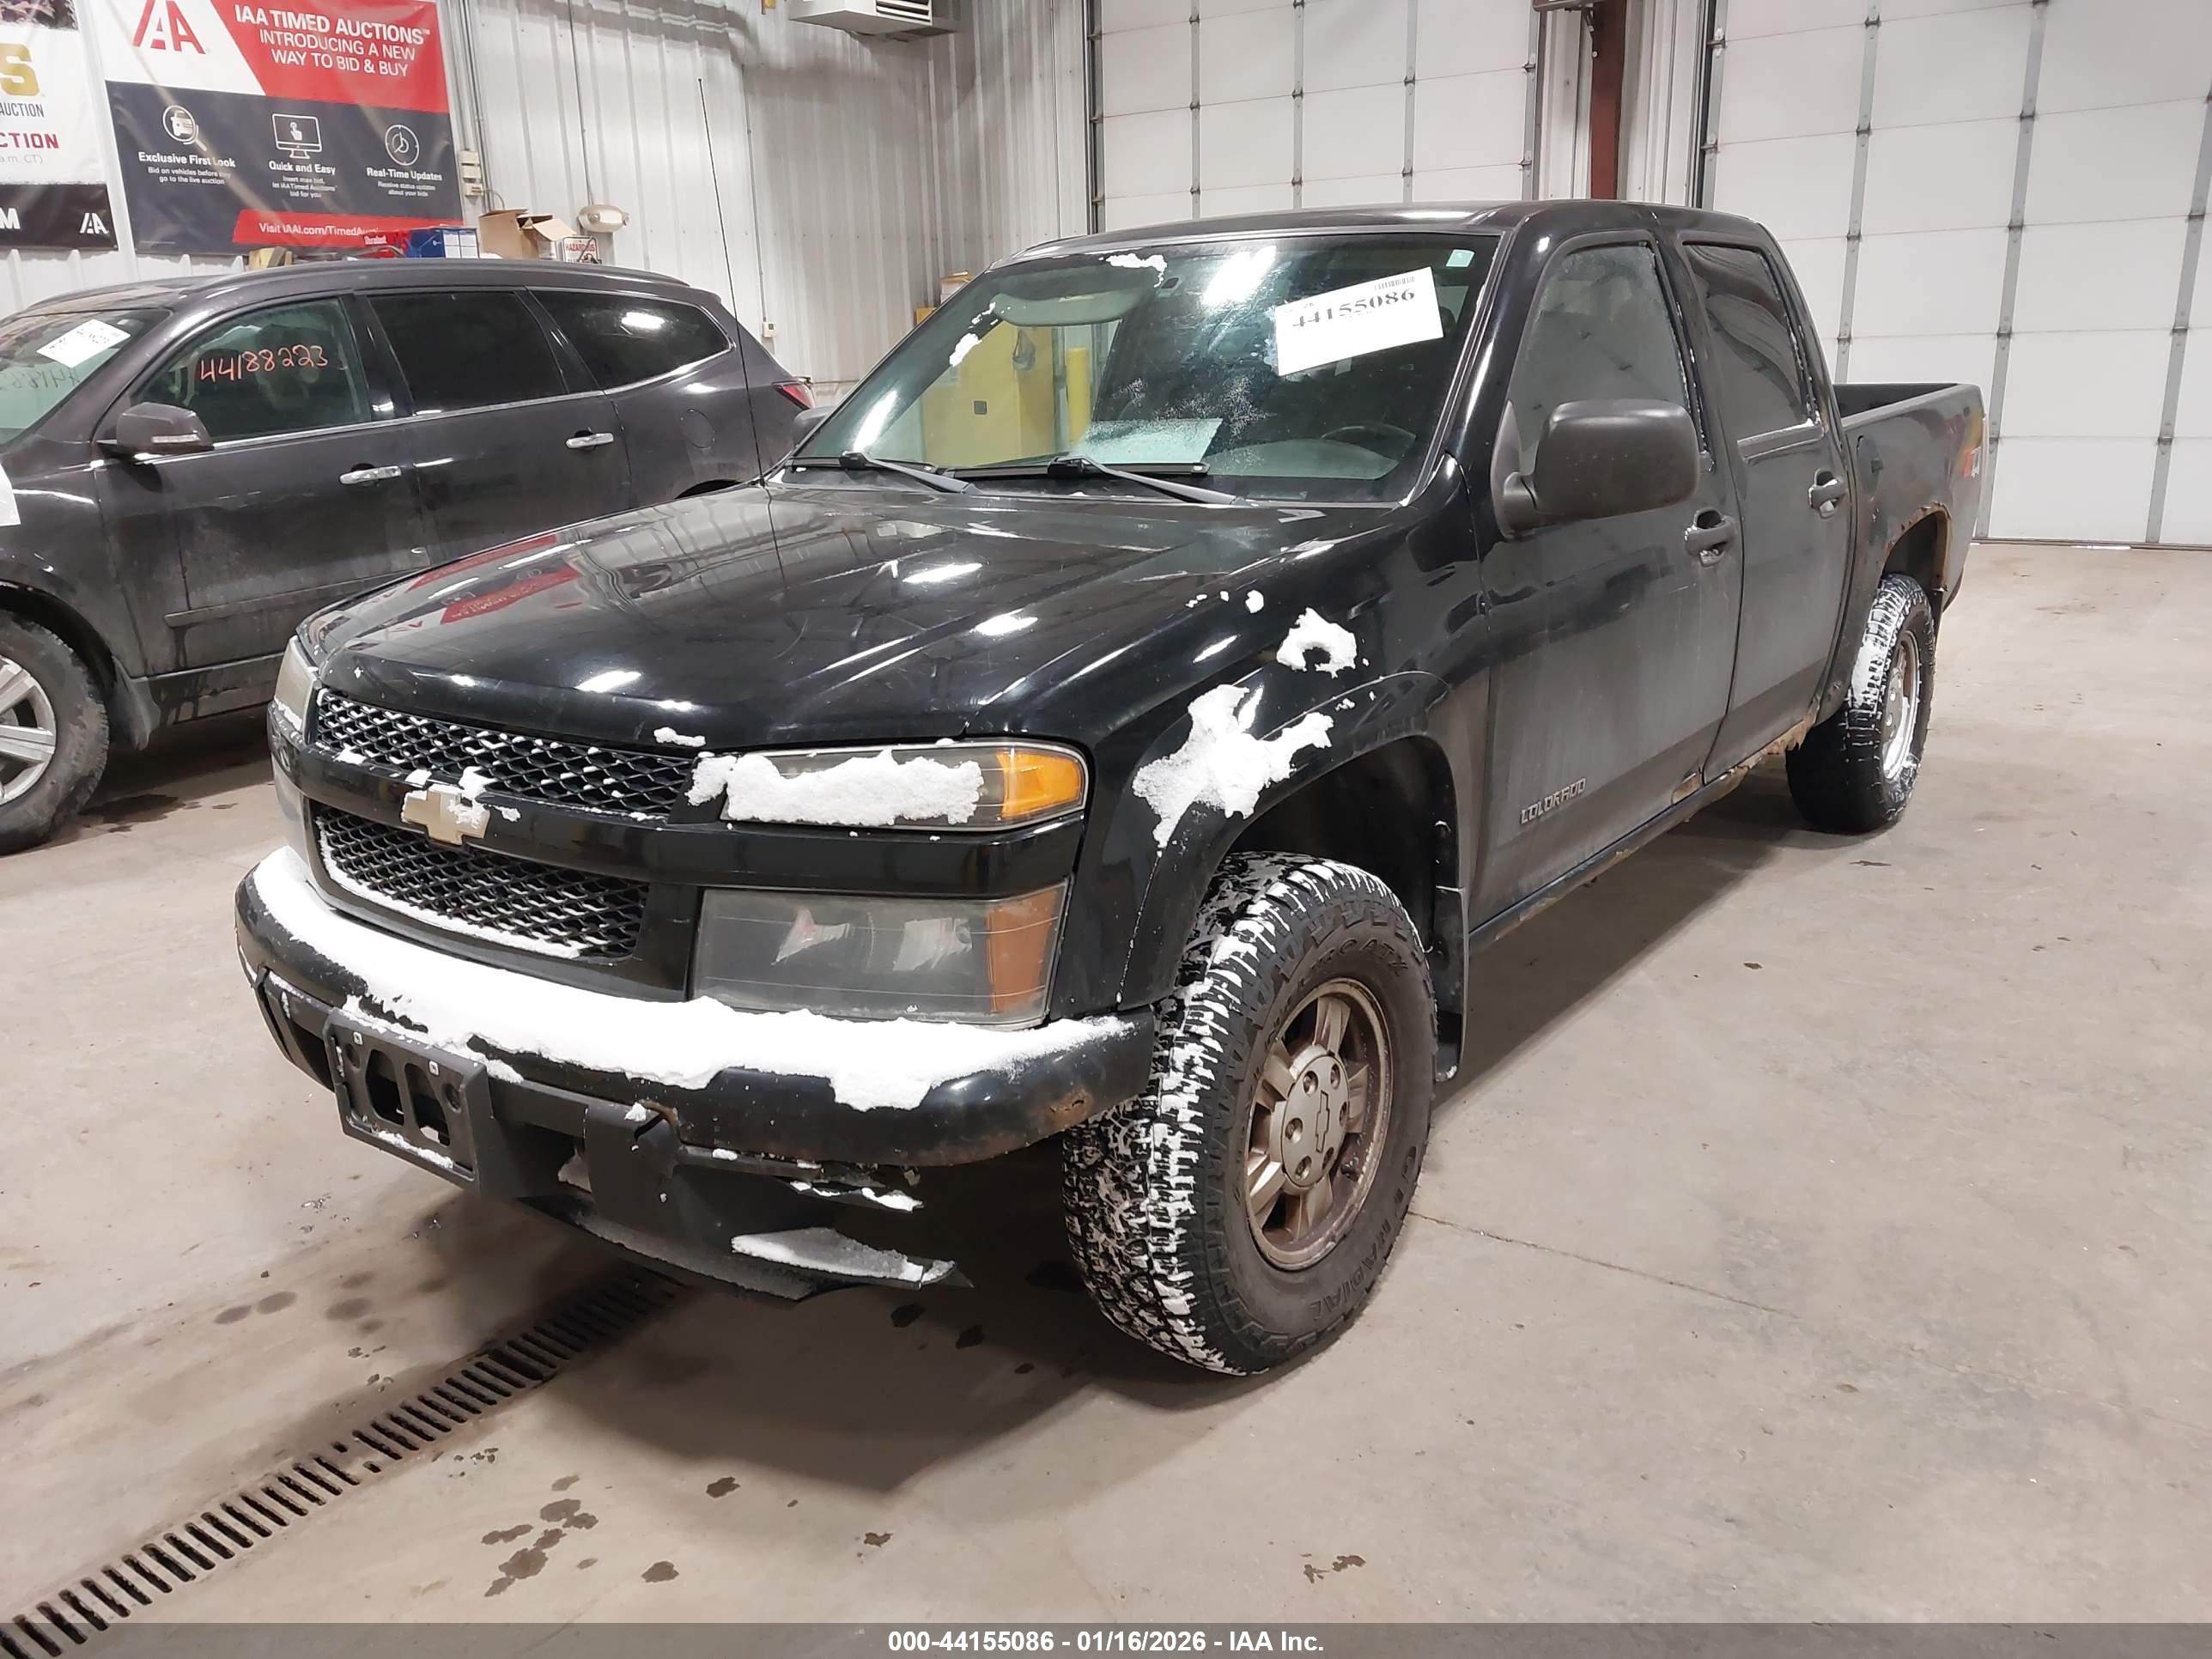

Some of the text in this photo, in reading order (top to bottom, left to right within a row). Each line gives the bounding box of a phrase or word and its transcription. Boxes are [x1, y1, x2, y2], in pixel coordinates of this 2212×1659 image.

[234, 3, 268, 26] IAA
[270, 9, 330, 33] TIMED
[259, 28, 416, 61] INTRODUCING A NEW
[271, 49, 408, 77] WAY TO BID & BUY
[138, 152, 236, 168] Exclusive First Look
[172, 167, 197, 176] vehicles
[269, 160, 336, 176] Quick and Easy
[367, 167, 442, 181] Real-Time Updates
[258, 222, 282, 234] Visit
[1292, 288, 1415, 327] 44155086
[200, 344, 328, 382] 44188223
[1521, 777, 1586, 824] COLORADO
